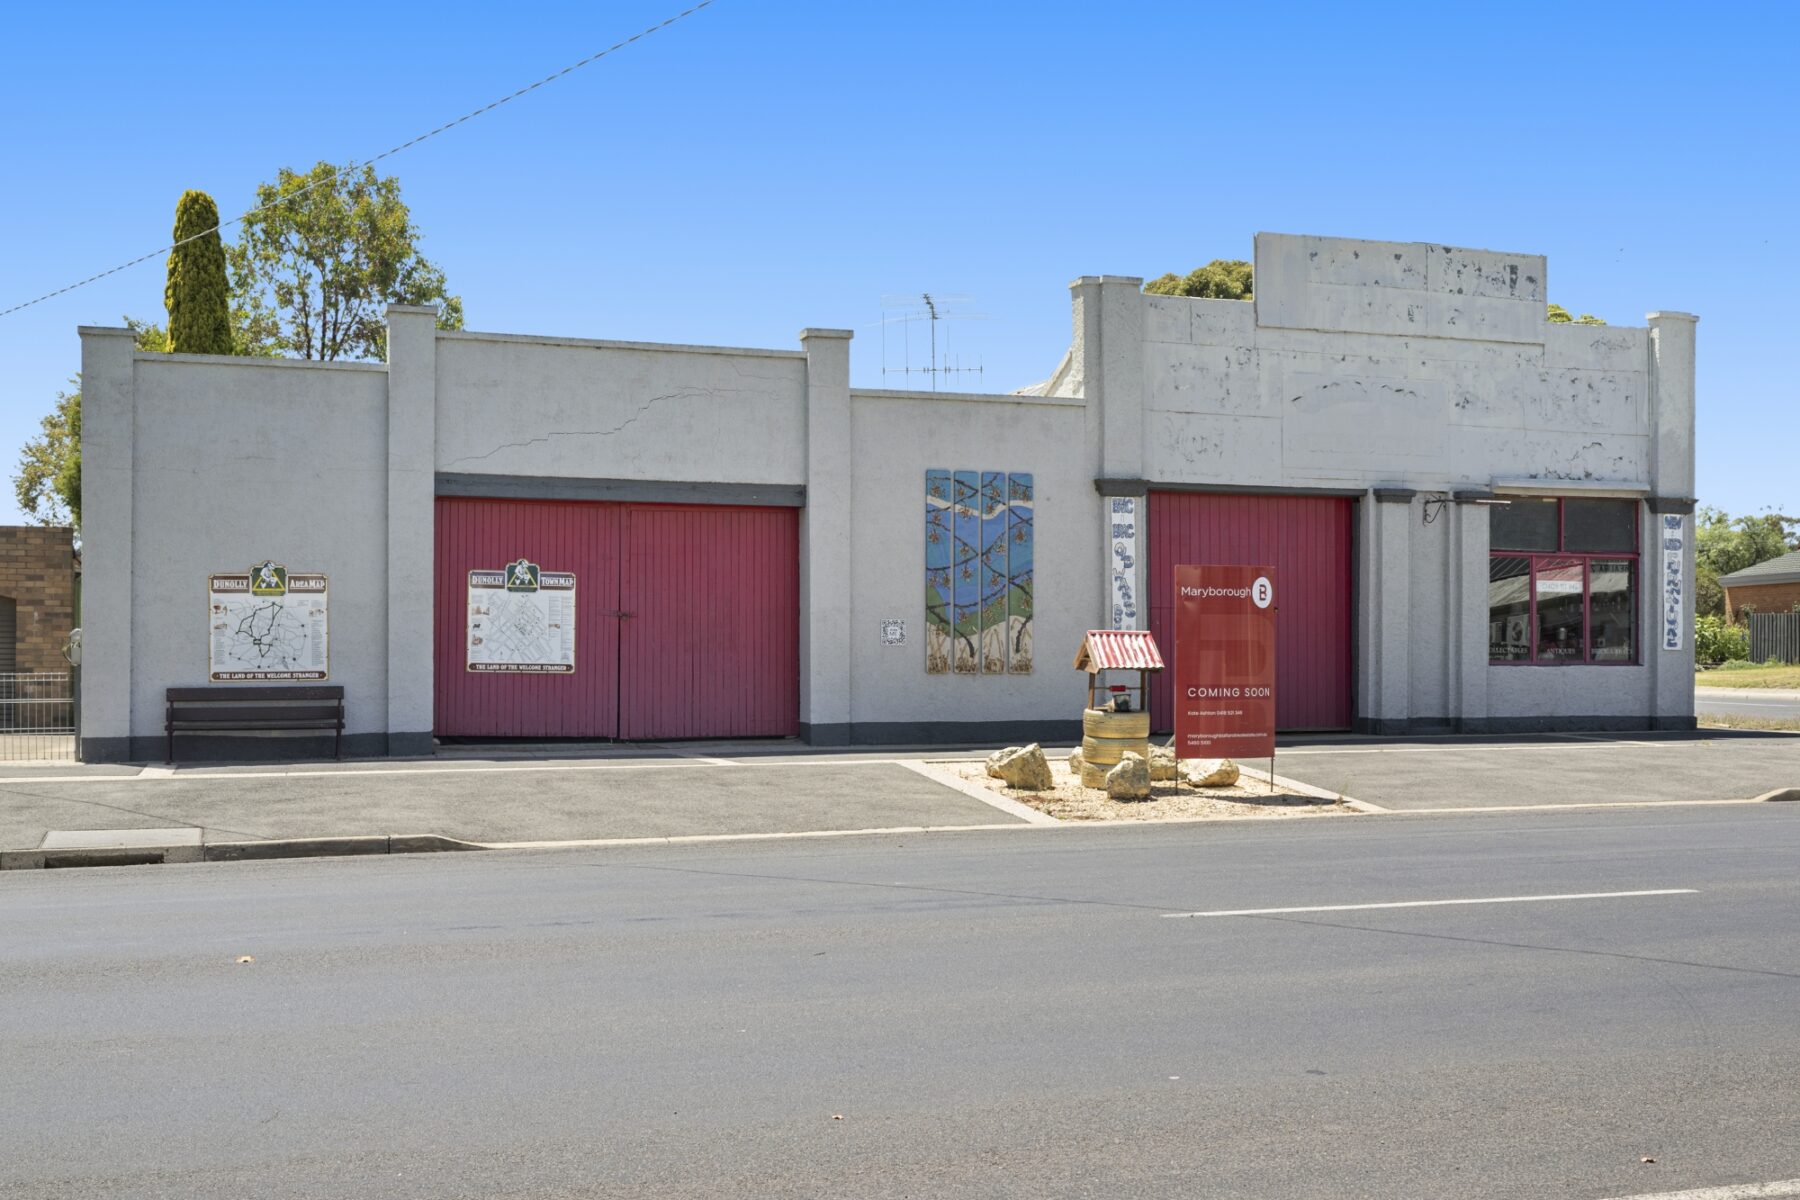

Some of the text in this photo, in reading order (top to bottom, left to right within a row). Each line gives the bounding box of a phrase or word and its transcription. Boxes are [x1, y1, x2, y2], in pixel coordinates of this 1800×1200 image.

[213, 579, 248, 589] DUNOLLY
[471, 575, 503, 584] DUNOLLY
[1181, 586, 1251, 598] Maryborough
[292, 671, 320, 679] STRANGER
[1187, 687, 1270, 698] COMING SOON
